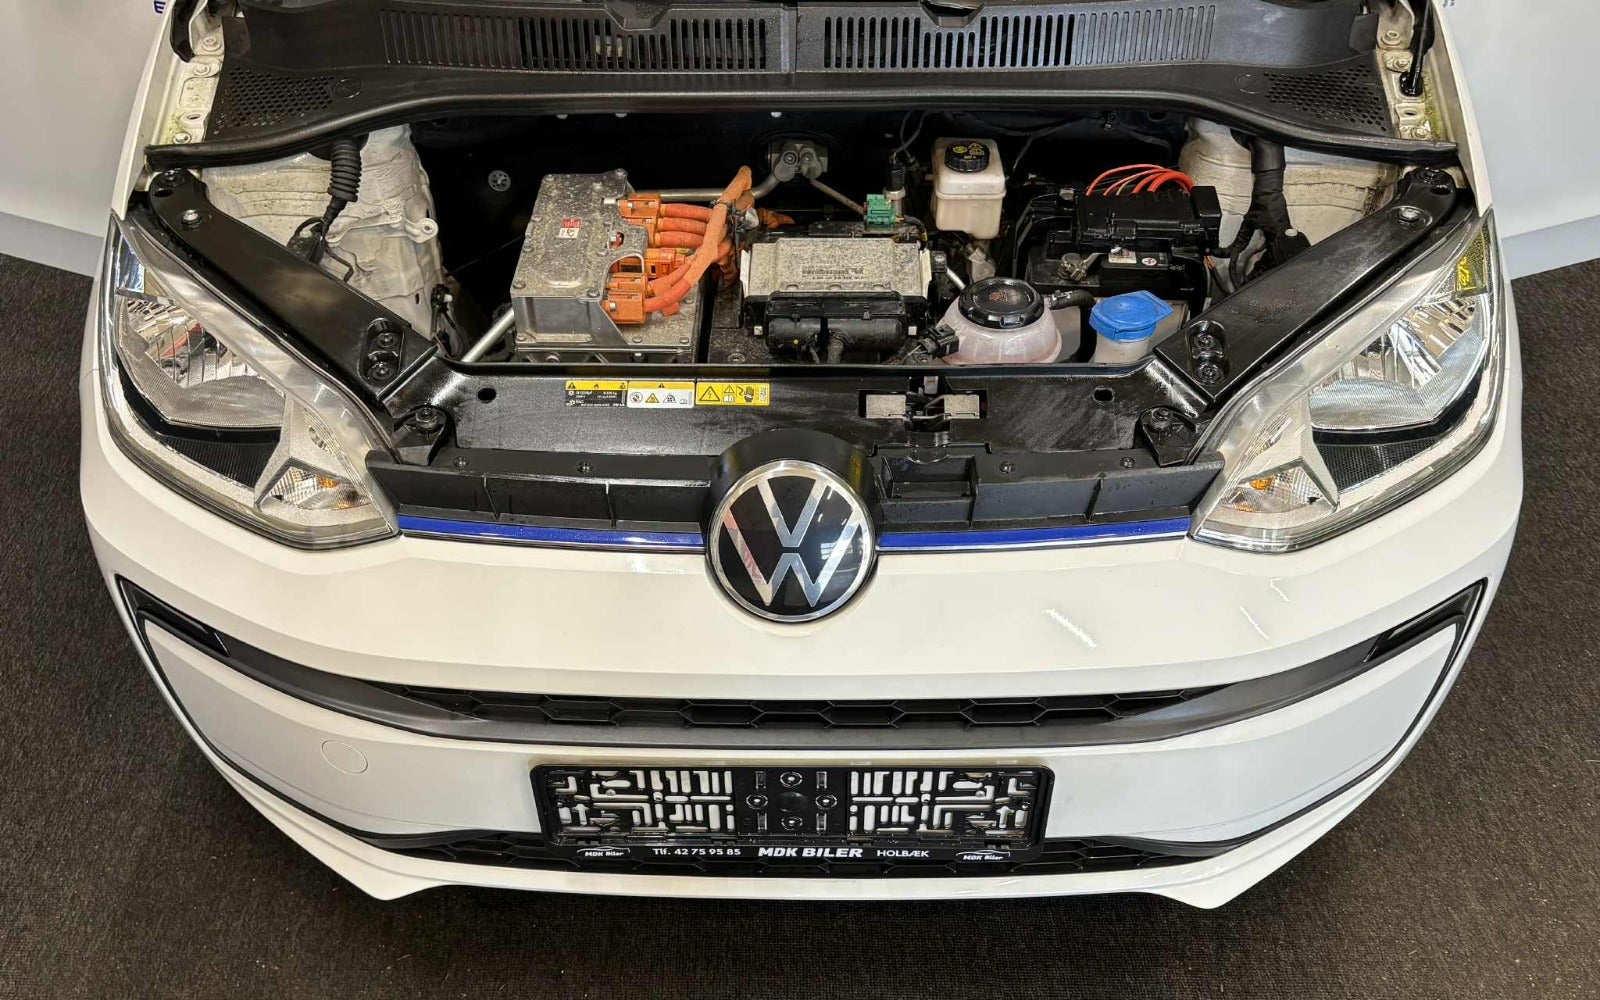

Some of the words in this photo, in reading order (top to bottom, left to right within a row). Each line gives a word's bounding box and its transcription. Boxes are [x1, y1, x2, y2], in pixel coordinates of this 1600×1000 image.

[652, 848, 671, 856] Tlf.
[674, 848, 689, 856] 42
[691, 848, 706, 856] 75
[708, 848, 724, 856] 95
[726, 848, 741, 856] 85
[758, 847, 798, 857] MDK
[802, 847, 864, 858] BILER
[876, 849, 930, 858] HOLBÆK
